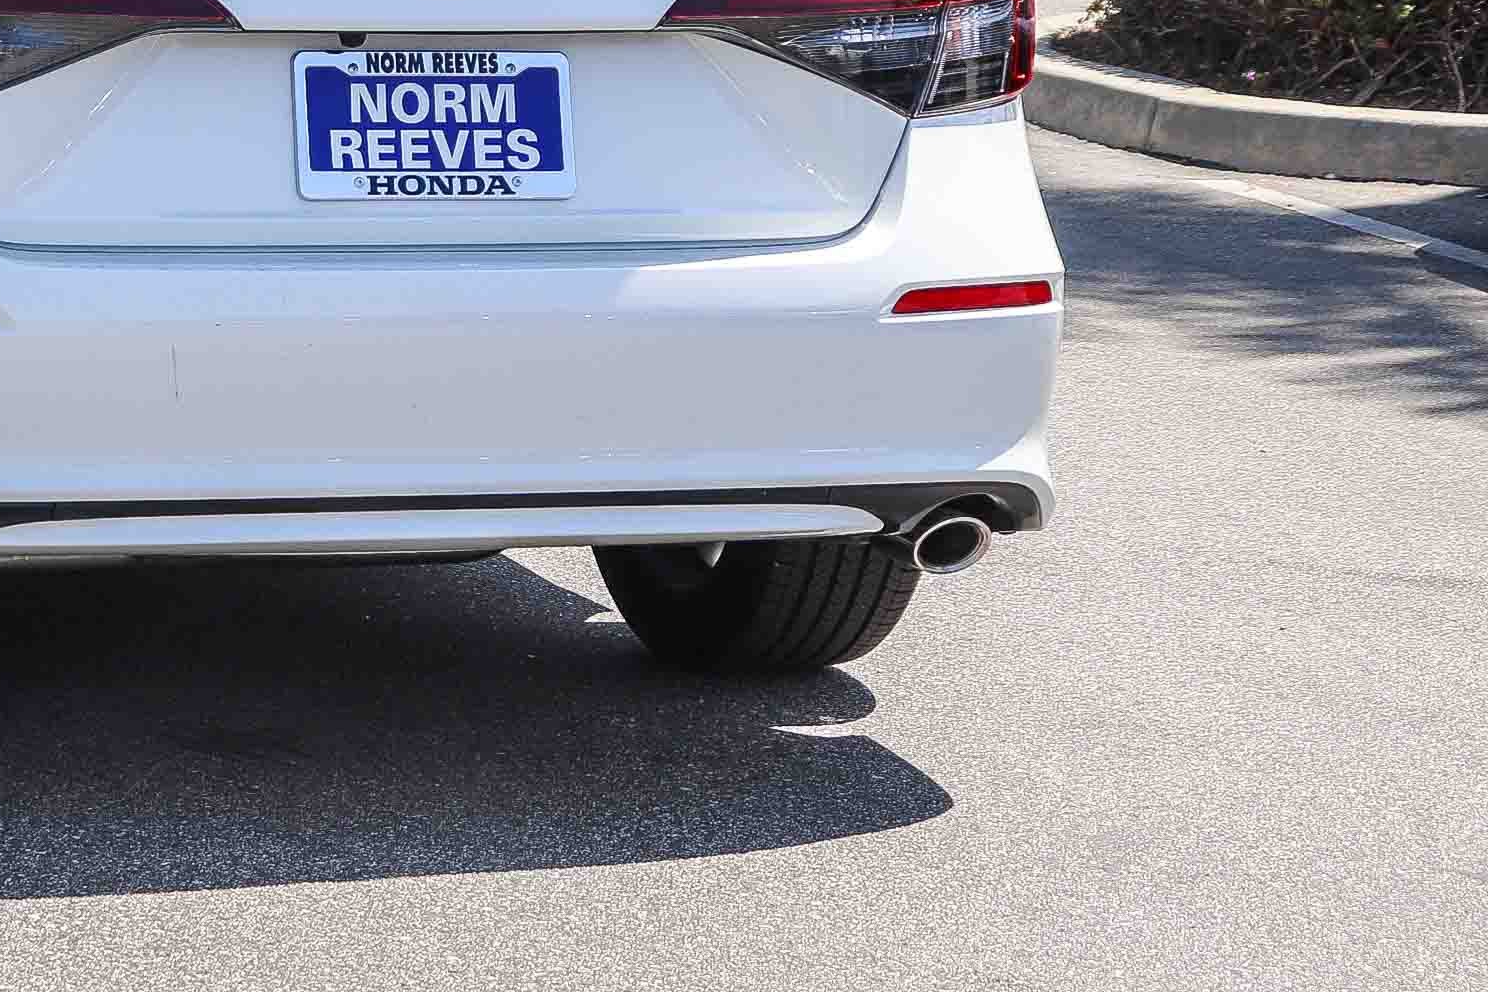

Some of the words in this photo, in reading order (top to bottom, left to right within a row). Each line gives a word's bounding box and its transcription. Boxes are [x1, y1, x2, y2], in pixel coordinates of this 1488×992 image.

[365, 52, 426, 74] NORM
[432, 52, 499, 74] REEVES
[350, 82, 517, 124] NORM
[329, 128, 541, 171] REEVES
[366, 174, 517, 196] HONDA
